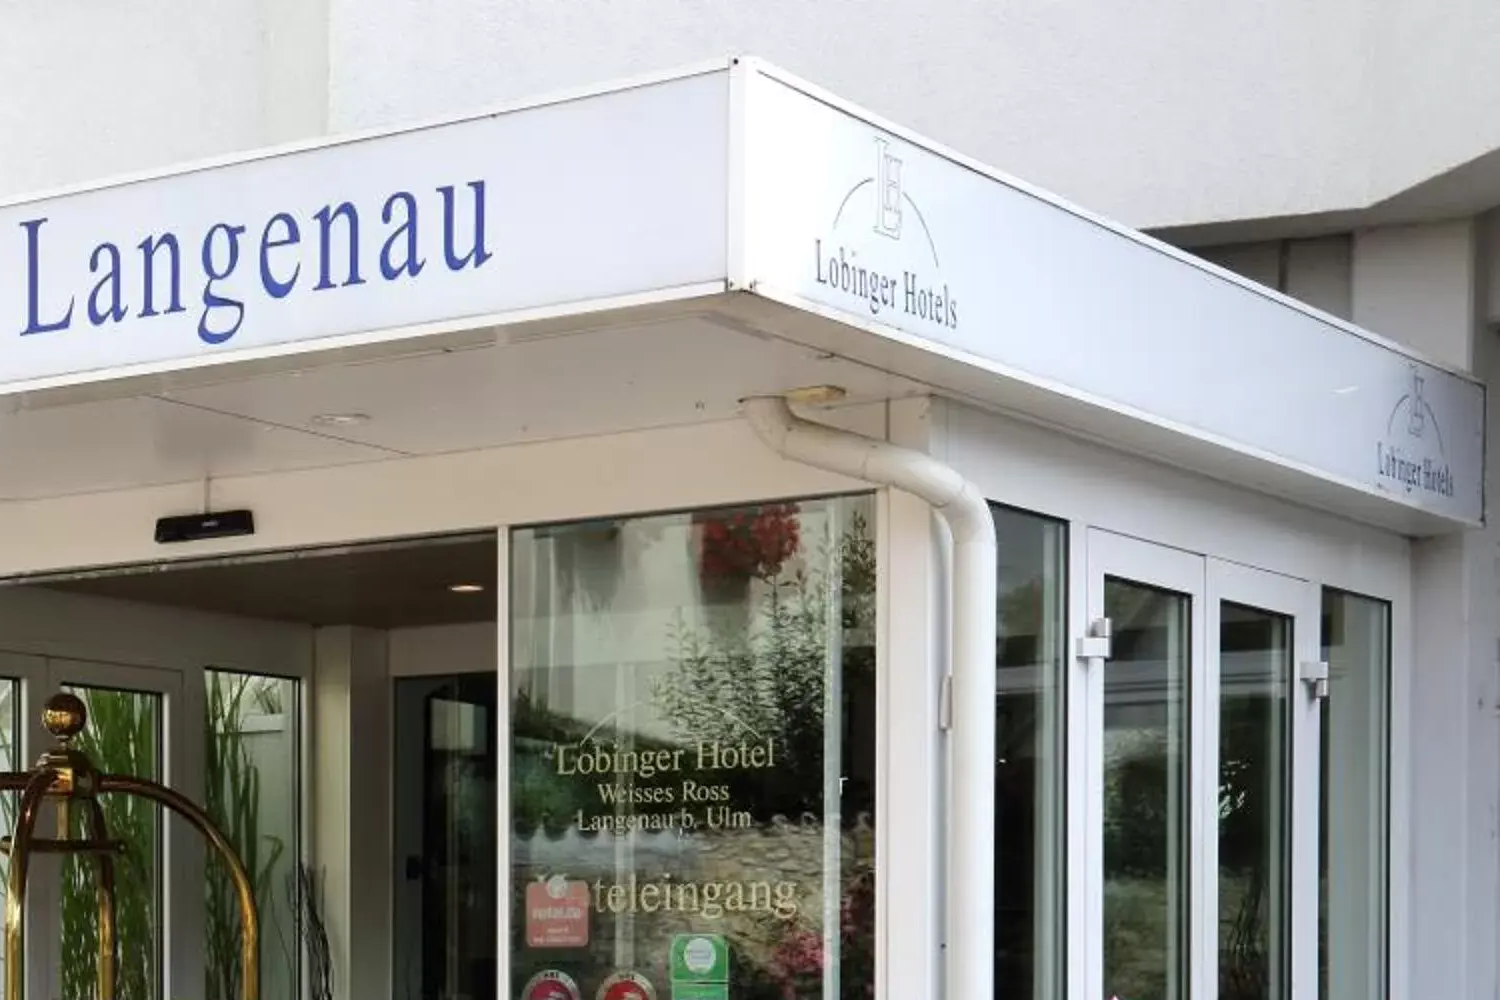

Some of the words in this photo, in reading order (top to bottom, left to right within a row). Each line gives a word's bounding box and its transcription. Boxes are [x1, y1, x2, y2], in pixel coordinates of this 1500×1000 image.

[20, 179, 491, 344] Langenau
[815, 238, 897, 314] Lobinger
[903, 271, 957, 329] Hotels
[1377, 440, 1421, 493] Lobinger
[1422, 457, 1453, 497] Hotels
[555, 743, 684, 778] Lobinger
[697, 737, 776, 770] Hotel
[597, 784, 674, 803] Weisses
[683, 779, 730, 801] Ross
[577, 810, 673, 836] Langenau
[681, 808, 698, 829] b.
[707, 807, 751, 828] Ulm
